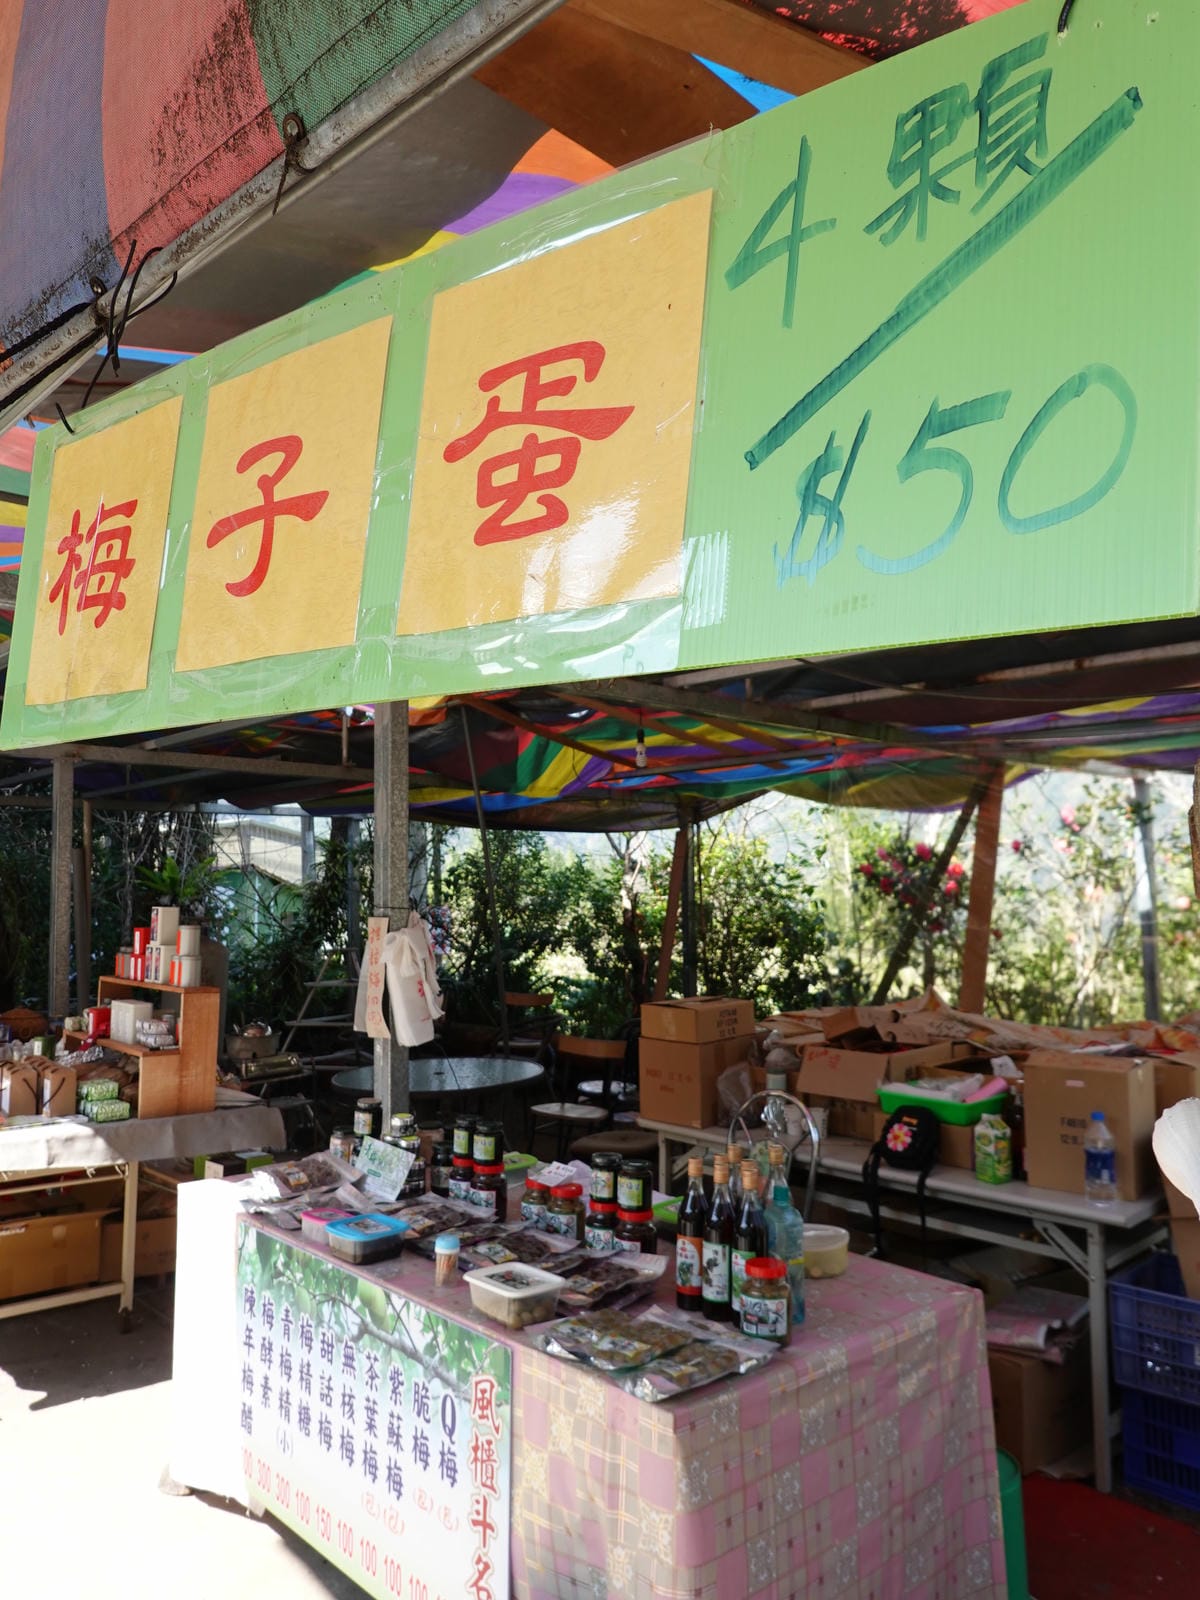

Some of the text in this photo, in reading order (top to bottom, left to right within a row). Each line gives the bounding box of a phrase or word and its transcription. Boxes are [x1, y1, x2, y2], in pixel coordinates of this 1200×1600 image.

[48, 340, 635, 636] 梅子蛋
[773, 362, 1138, 590] $50
[316, 1331, 335, 1542] 甜話梅 150
[337, 1340, 356, 1558] 無核梅 100
[361, 1352, 380, 1485] 茶葉梅
[385, 1364, 404, 1501] 紫蘇梅
[411, 1380, 431, 1472] 脆梅
[438, 1393, 459, 1489] Q梅
[295, 1488, 310, 1526] 100
[359, 1536, 376, 1577] 100
[384, 1555, 402, 1597] 100
